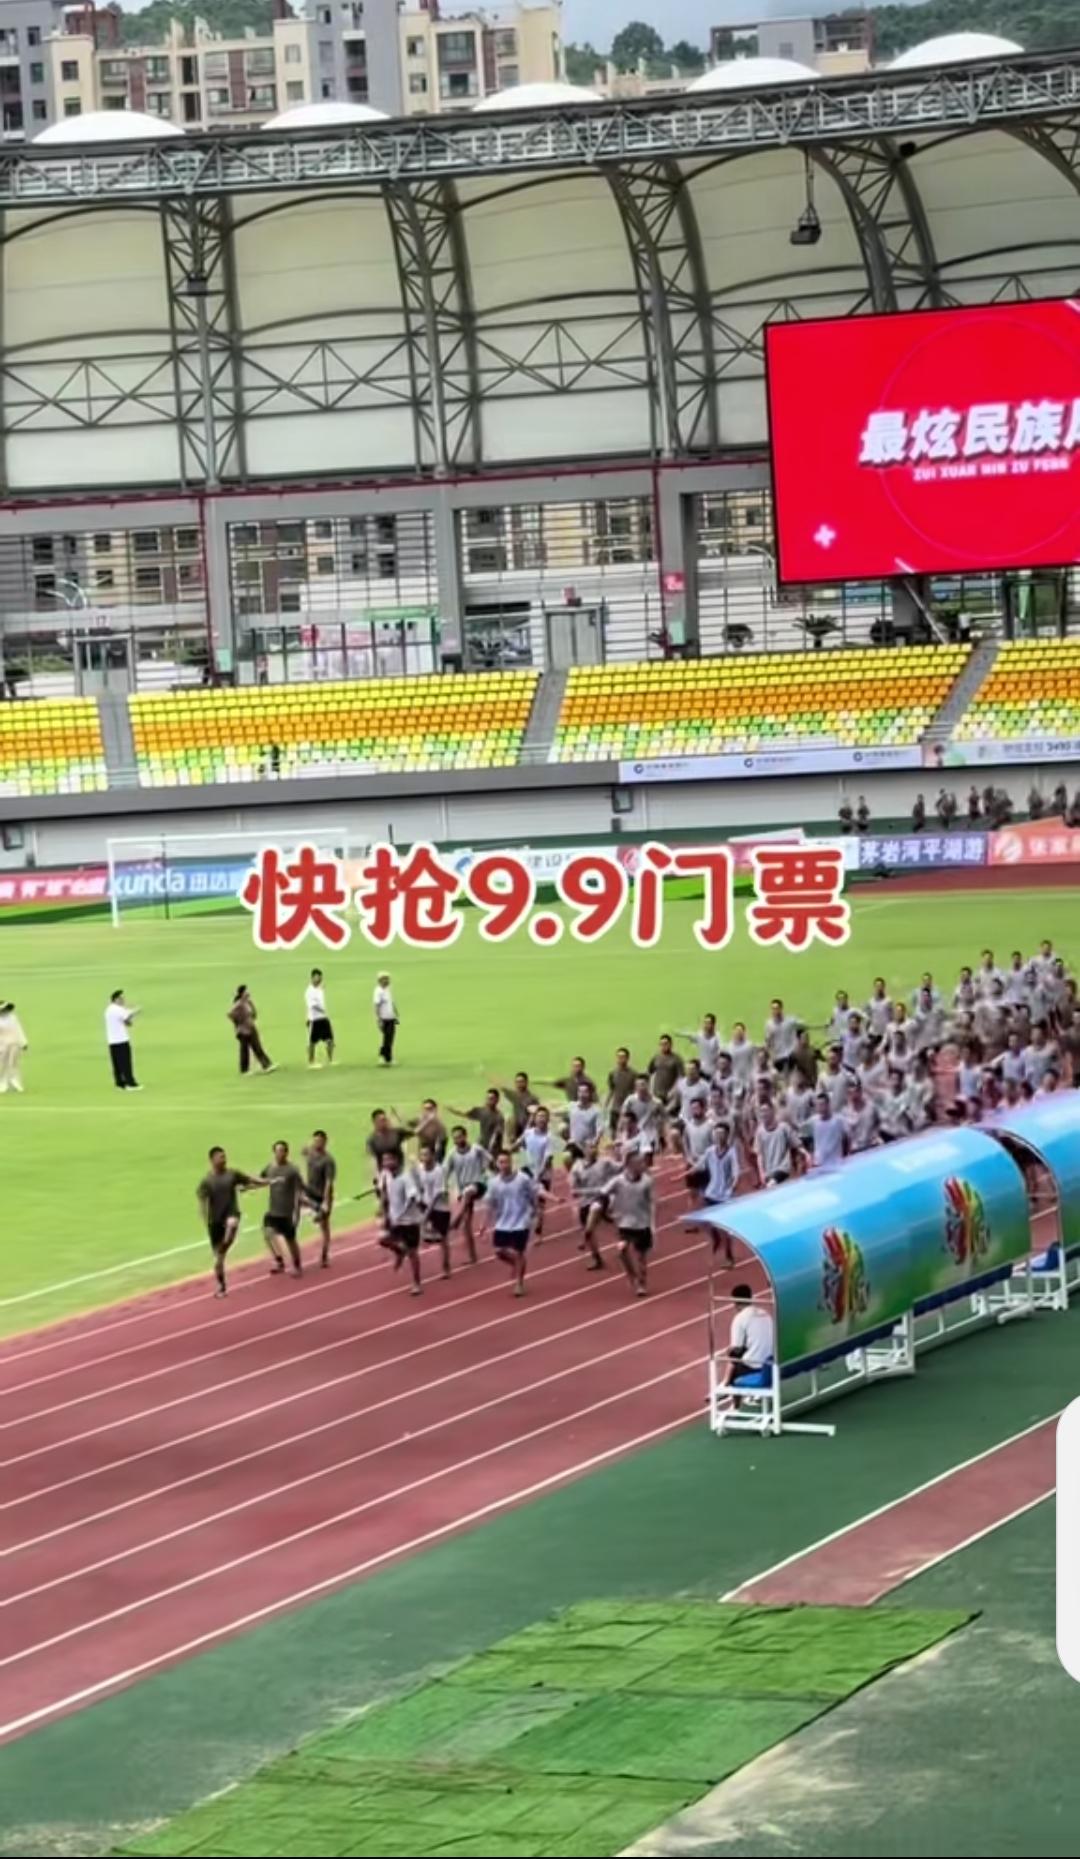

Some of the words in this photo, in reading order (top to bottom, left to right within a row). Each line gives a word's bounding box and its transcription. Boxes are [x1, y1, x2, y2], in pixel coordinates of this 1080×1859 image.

[913, 467, 936, 482] ZUI
[861, 837, 985, 863] 茅岩河平湖游
